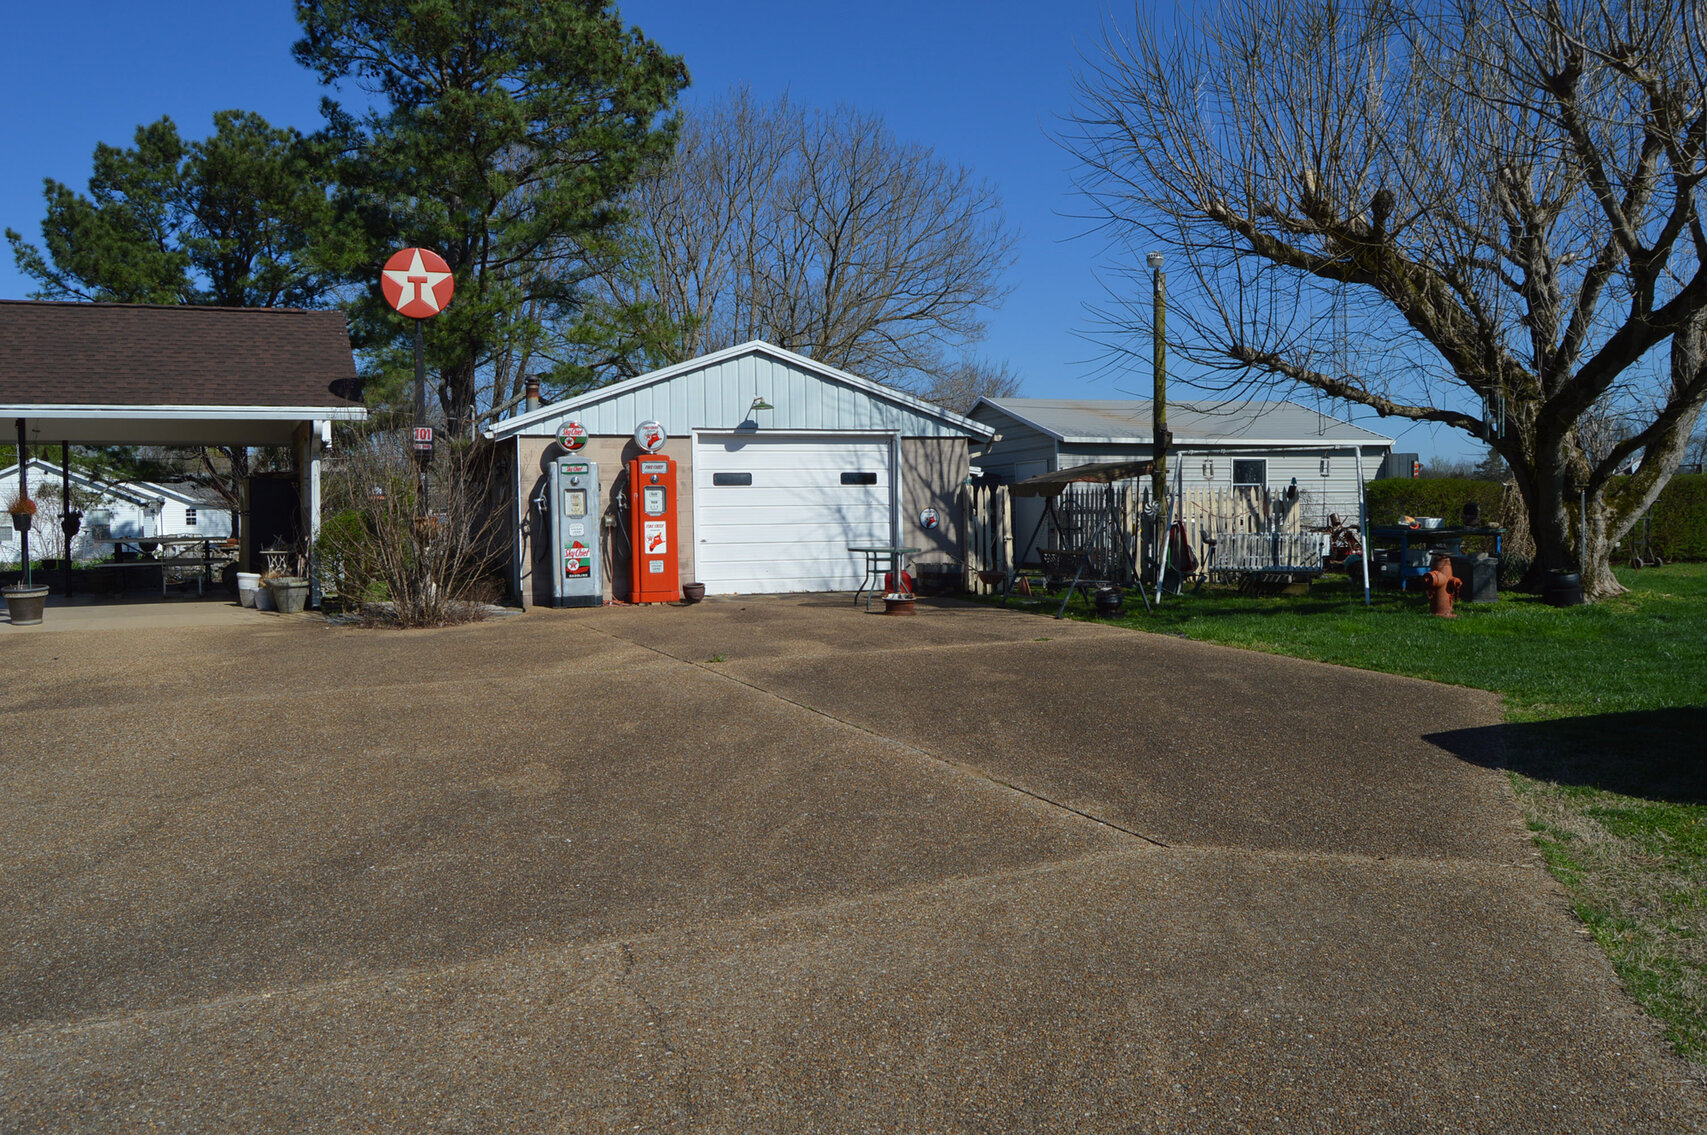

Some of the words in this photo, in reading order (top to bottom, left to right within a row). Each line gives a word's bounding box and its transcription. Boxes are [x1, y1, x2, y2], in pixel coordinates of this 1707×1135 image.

[407, 275, 428, 301] T
[415, 428, 431, 440] 101
[562, 427, 572, 437] Sky
[571, 427, 584, 436] Chief
[565, 548, 575, 558] Sky
[575, 548, 590, 557] Chief
